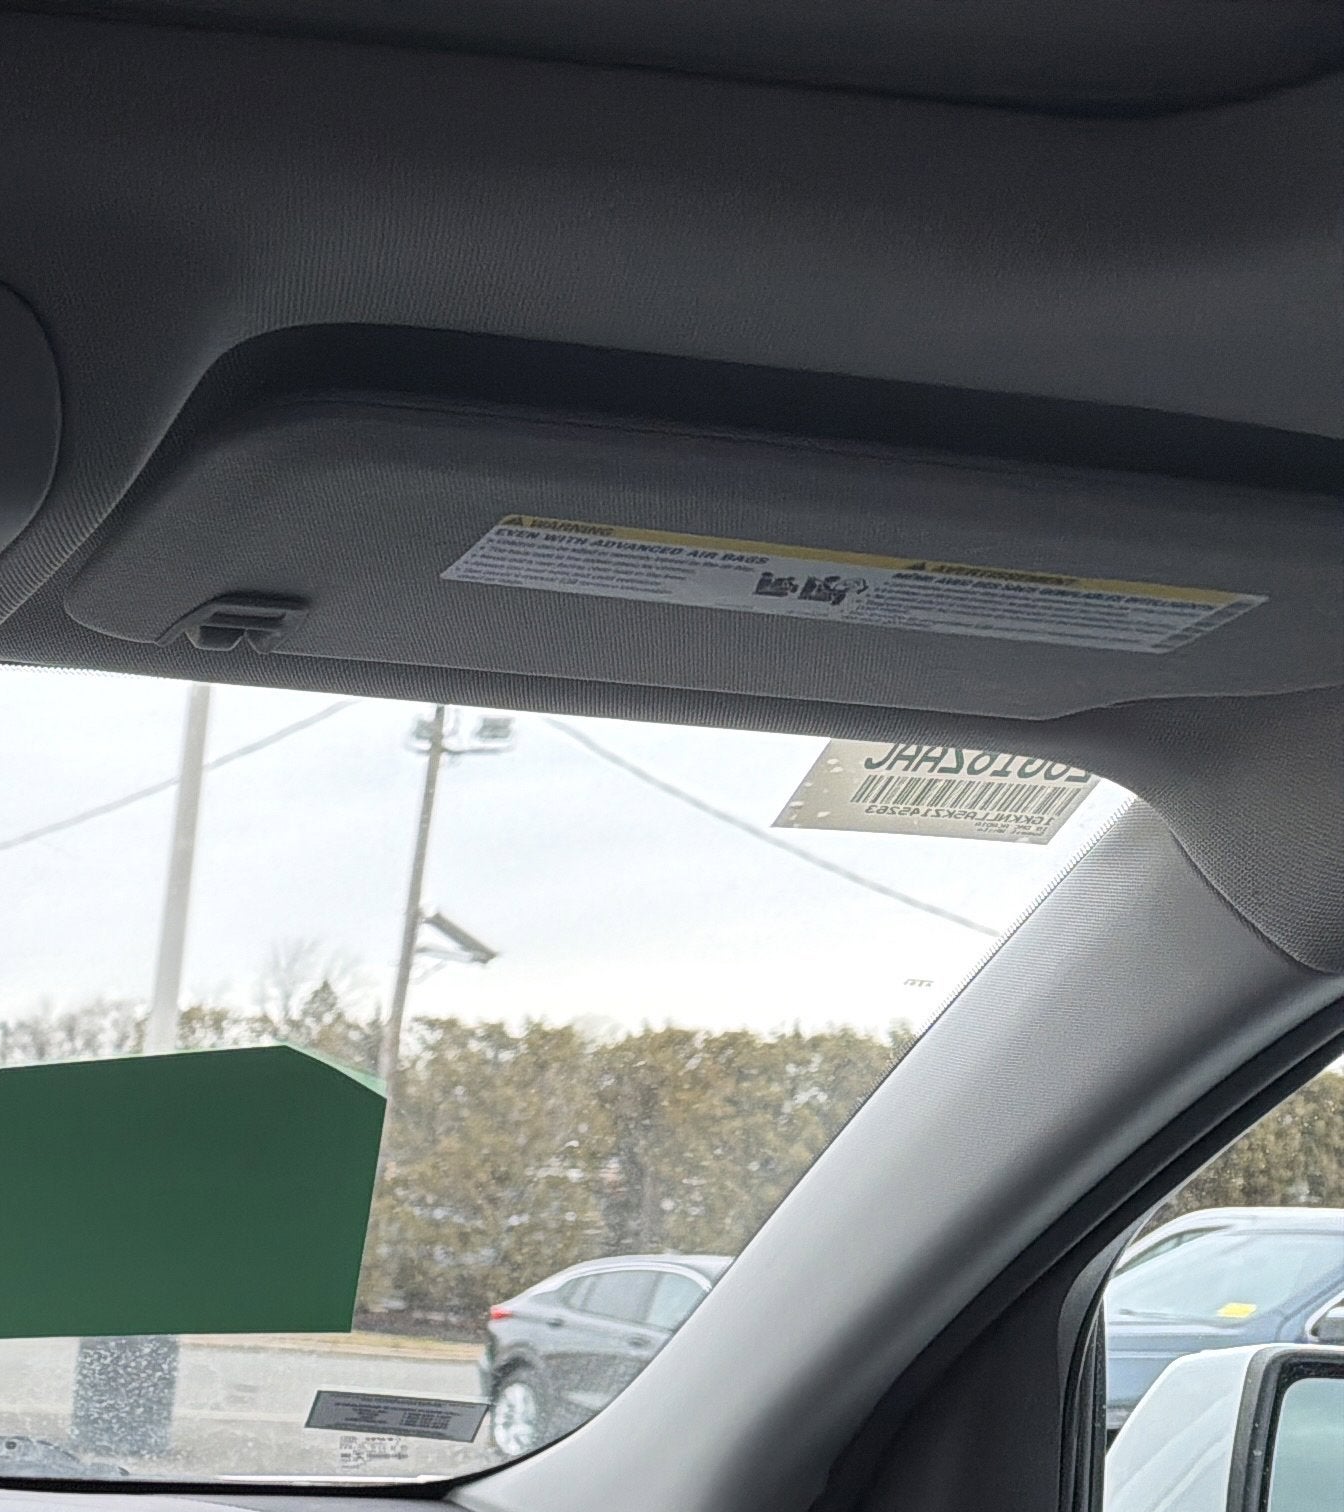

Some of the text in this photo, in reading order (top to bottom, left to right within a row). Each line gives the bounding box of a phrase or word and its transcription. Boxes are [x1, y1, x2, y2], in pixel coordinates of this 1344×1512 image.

[530, 520, 613, 536] WARNING
[495, 528, 769, 565] EVEN WITH ADVANCED AIR BAGS
